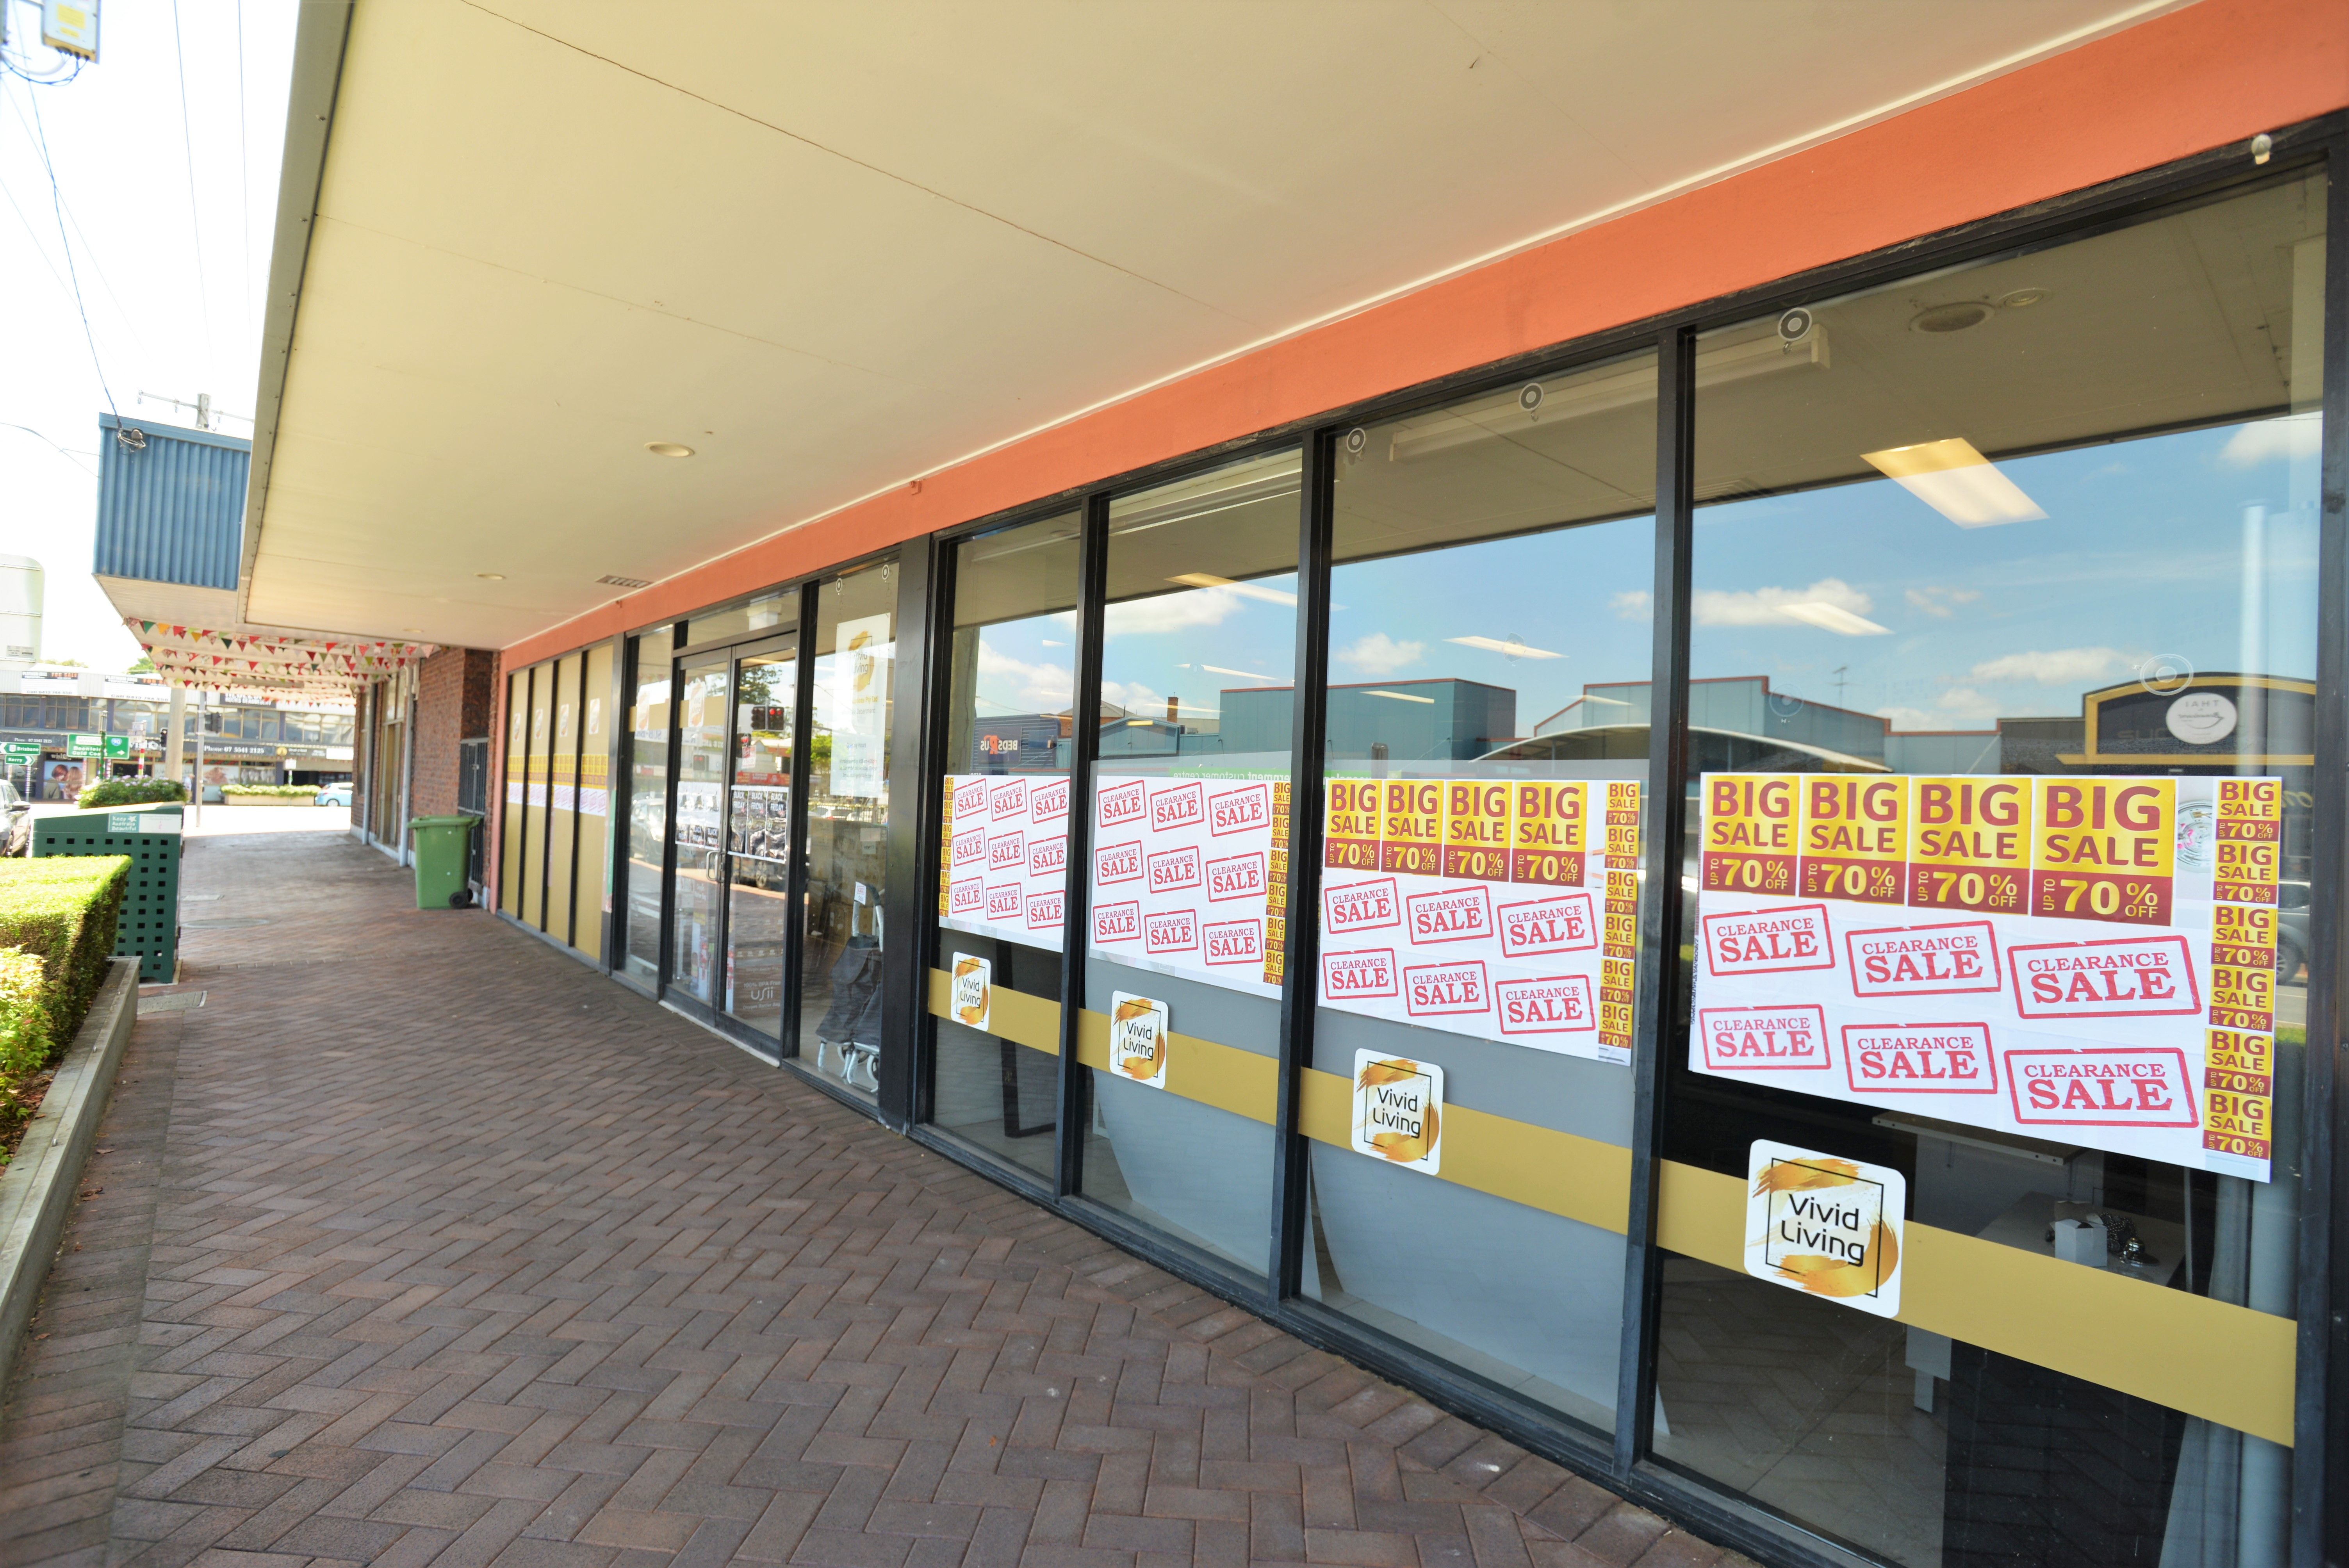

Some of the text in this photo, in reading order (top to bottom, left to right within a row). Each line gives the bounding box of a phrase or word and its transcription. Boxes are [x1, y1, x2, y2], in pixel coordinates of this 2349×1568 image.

[734, 791, 745, 799] BLACK
[752, 792, 763, 800] BLACK
[771, 793, 783, 801] BLACK
[957, 786, 983, 800] CLEARANCE
[994, 786, 1022, 801] CLEARANCE
[1035, 787, 1067, 802] CLEARANCE
[1103, 789, 1140, 803] CLEARANCE
[1274, 782, 1290, 794] BIG
[1274, 793, 1290, 802] SALE
[1610, 784, 1636, 798] BIG
[2221, 781, 2274, 802] BIG
[733, 801, 745, 809] FRIDAY
[751, 802, 763, 810] FRIDAY
[770, 803, 784, 811] FRIDAY
[958, 793, 984, 812] SALE
[995, 795, 1023, 814] SALE
[1035, 796, 1067, 816] SALE
[1104, 797, 1141, 818] SALE
[1156, 791, 1196, 806] CLEARANCE
[1215, 793, 1260, 810] CLEARANCE
[1331, 784, 1377, 813] BIG
[1388, 785, 1438, 814] BIG
[1451, 786, 1506, 818] BIG
[1520, 787, 1580, 820] BIG
[1609, 798, 1636, 809] SALE
[1713, 781, 1790, 818] BIG
[1811, 782, 1898, 822] BIG
[1920, 784, 2019, 825] BIG
[2046, 785, 2161, 831] BIG
[1157, 801, 1198, 823] SALE
[1216, 802, 1263, 827] SALE
[2221, 803, 2272, 817] SALE
[1331, 815, 1375, 835] SALE
[1388, 817, 1436, 838] SALE
[1451, 820, 1504, 842] SALE
[1519, 822, 1578, 845] SALE
[1712, 822, 1788, 848] SALE
[1810, 825, 1896, 853] SALE
[1919, 830, 2018, 860] SALE
[2045, 834, 2158, 868] SALE
[1766, 878, 1787, 890] OFF
[1870, 885, 1895, 898] OFF
[1333, 888, 1389, 904] CLEARANCE
[1416, 897, 1480, 913] CLEARANCE
[1989, 894, 2017, 908] OFF
[1334, 898, 1391, 924] SALE
[1417, 908, 1483, 934] SALE
[1508, 905, 1582, 923] CLEARANCE
[2125, 905, 2158, 918] OFF
[1510, 917, 1585, 946] SALE
[1717, 918, 1814, 937] CLEARANCE
[1719, 931, 1818, 963] SALE
[1862, 936, 1978, 955] CLEARANCE
[1864, 950, 1984, 984] SALE
[2027, 952, 2169, 971] CLEARANCE
[962, 977, 980, 992] Vivid
[1506, 985, 1580, 1000] CLEARANCE
[2031, 966, 2176, 1004] SALE
[960, 989, 981, 1009] Living
[1508, 998, 1583, 1023] SALE
[1126, 1021, 1152, 1040] Vivid
[1713, 1018, 1811, 1031] CLEARANCE
[1123, 1035, 1153, 1060] Living
[1716, 1030, 1814, 1058] SALE
[1858, 1037, 1974, 1050] CLEARANCE
[1861, 1051, 1978, 1079] SALE
[2024, 1064, 2165, 1078] CLEARANCE
[1377, 1087, 1417, 1113] Vivid
[2027, 1079, 2173, 1111] SALE
[1373, 1107, 1420, 1139] Living
[1789, 1193, 1859, 1232] Vivid
[1781, 1220, 1864, 1267] Living
